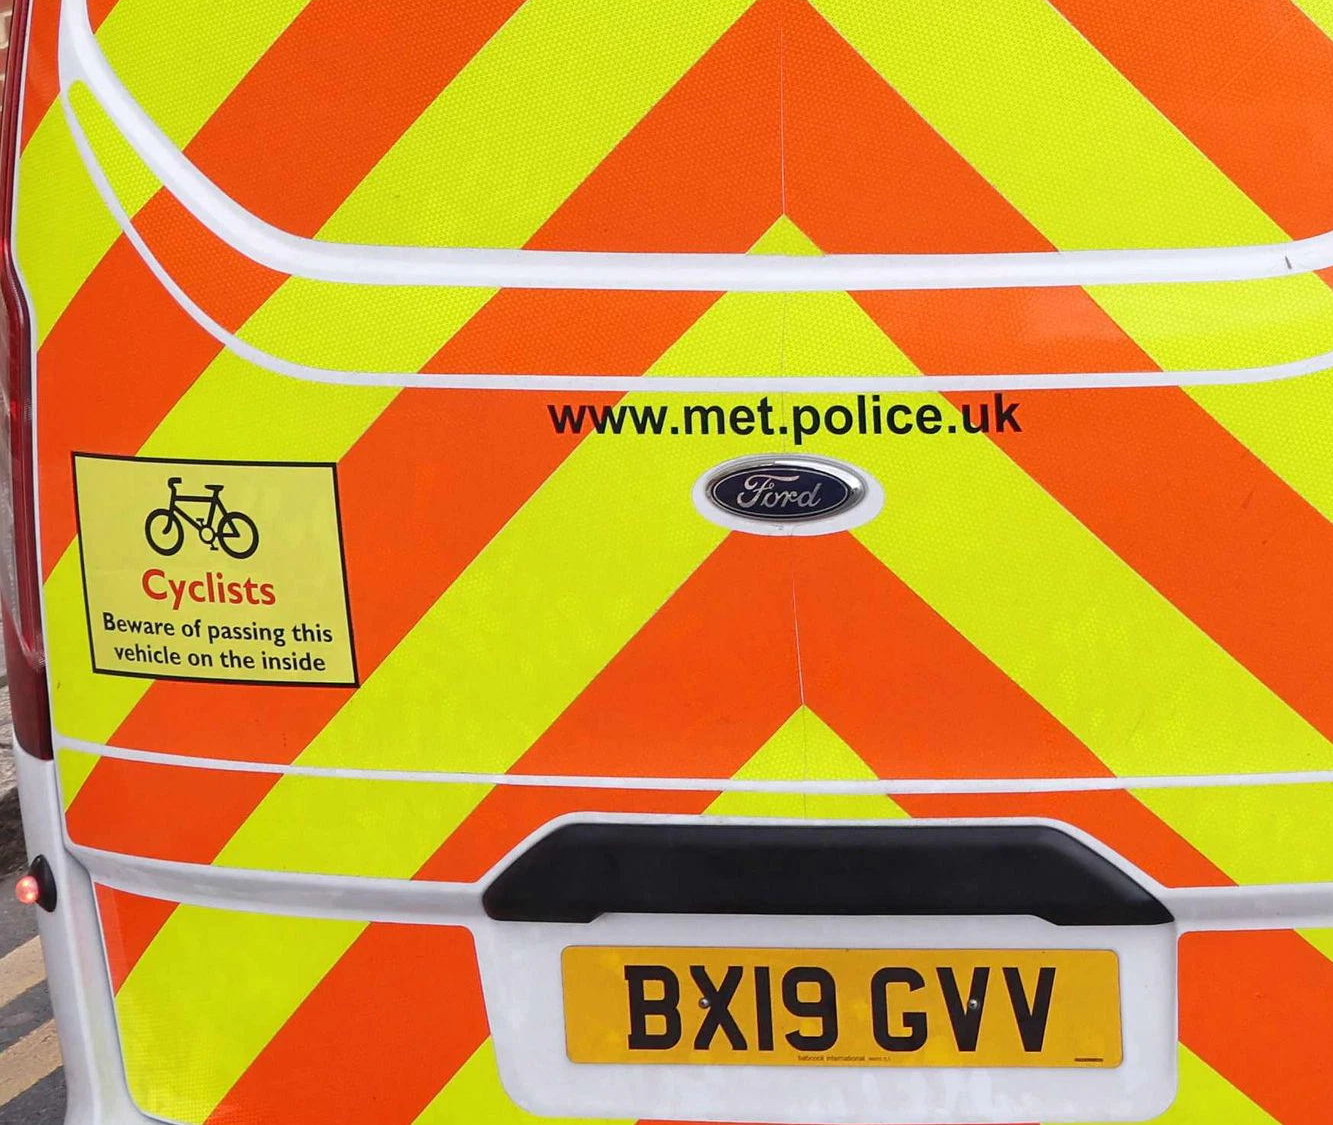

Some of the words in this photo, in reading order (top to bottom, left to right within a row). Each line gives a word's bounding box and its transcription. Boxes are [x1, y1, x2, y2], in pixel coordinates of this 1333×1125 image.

[547, 393, 1023, 446] www.met.police.uk
[736, 474, 822, 511] Ford
[141, 568, 276, 611] Cyclists
[102, 611, 175, 637] Beware
[181, 619, 202, 638] of
[207, 622, 286, 647] passing
[292, 623, 334, 644] this
[114, 643, 181, 665] vehicle
[187, 653, 214, 668] on
[220, 649, 256, 670] the
[261, 650, 327, 672] inside
[623, 964, 839, 1052] BX19
[870, 966, 1057, 1053] GVV
